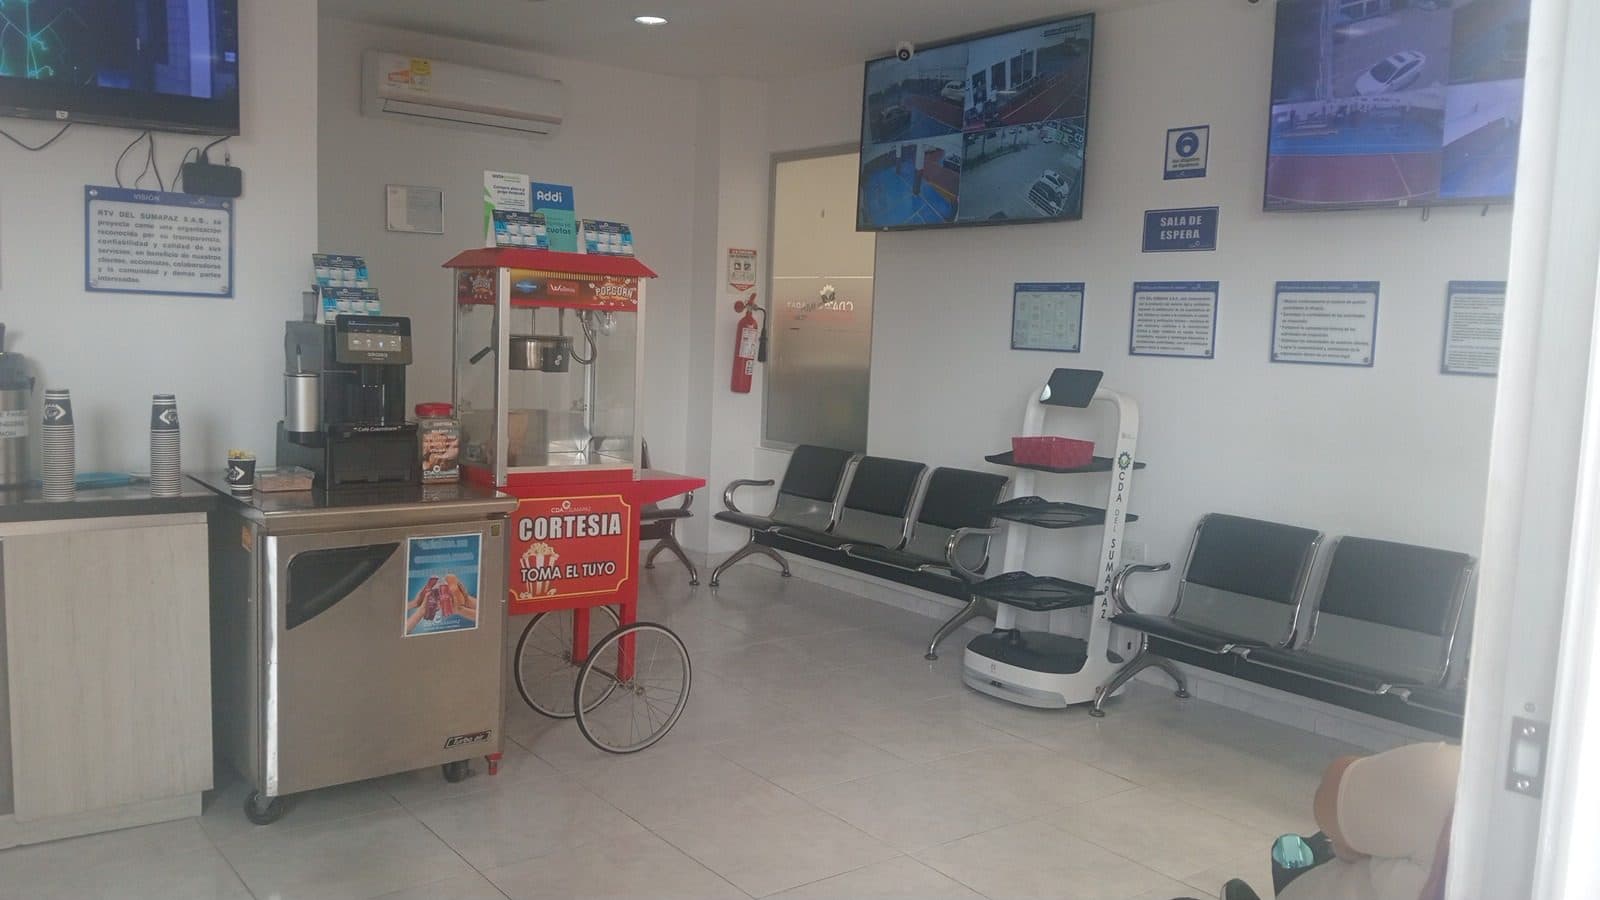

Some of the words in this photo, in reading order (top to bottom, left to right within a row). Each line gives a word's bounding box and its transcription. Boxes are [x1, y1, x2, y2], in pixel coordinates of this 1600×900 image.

[536, 190, 563, 203] Addi
[140, 212, 179, 222] SUMAPAZ
[1160, 216, 1186, 227] SALA
[1188, 215, 1202, 225] DE
[134, 222, 155, 230] como
[97, 229, 139, 238] reconocida
[1160, 229, 1200, 240] ESPERA
[97, 239, 149, 248] confiabilidad
[162, 242, 191, 250] calidad
[194, 243, 204, 251] de
[146, 250, 179, 258] beneficio
[118, 267, 160, 275] comunidad
[595, 286, 633, 298] POPCORN
[1116, 471, 1126, 502] CDA
[518, 513, 622, 542] CORTESIA
[520, 567, 561, 583] TOMA
[566, 566, 578, 578] EL
[582, 562, 616, 576] TUYO
[1101, 539, 1117, 619] SUMAPAZ
